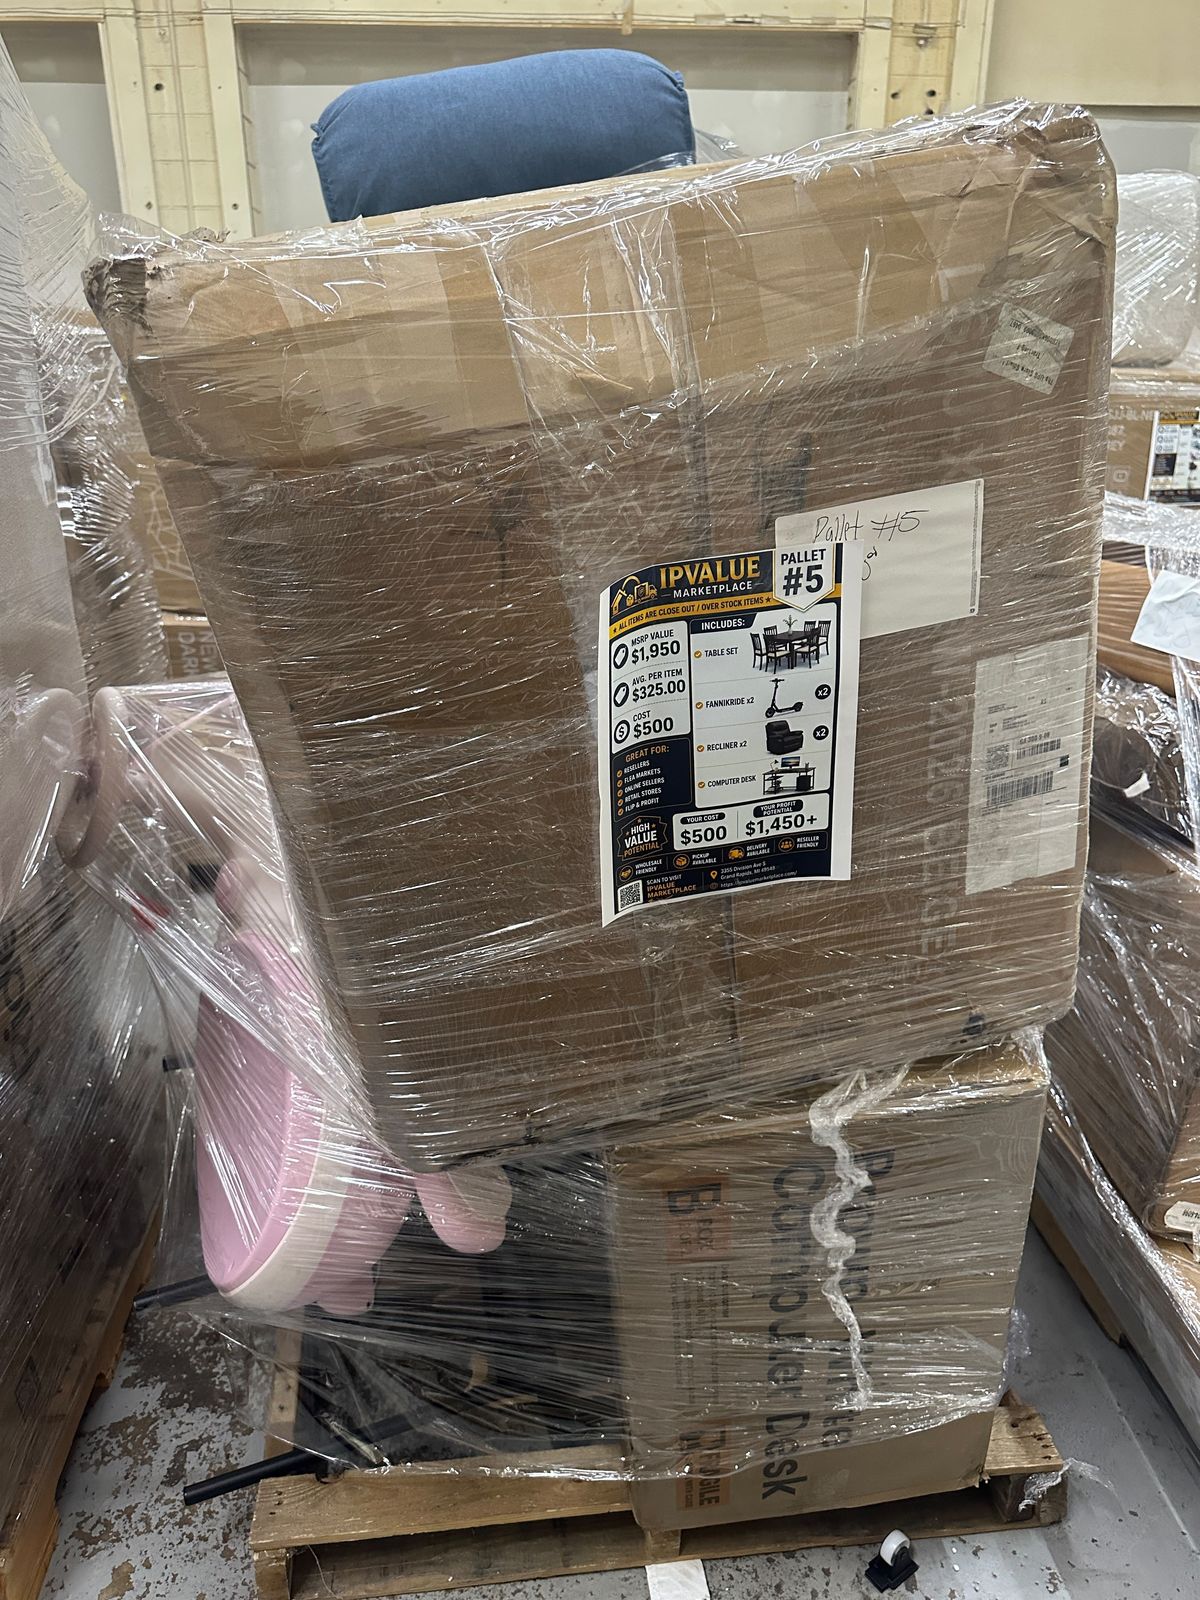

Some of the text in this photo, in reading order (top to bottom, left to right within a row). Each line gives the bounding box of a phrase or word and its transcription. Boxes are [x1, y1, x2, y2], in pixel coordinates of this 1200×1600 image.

[871, 510, 930, 542] #5
[781, 548, 827, 565] PALLET
[659, 555, 761, 589] IPVALUE
[782, 564, 824, 597] #5
[673, 581, 753, 599] MARKETPLACE
[628, 614, 644, 626] ITEMS
[645, 610, 657, 619] ARE
[659, 607, 680, 615] CLOSE
[682, 605, 696, 613] OUT
[721, 600, 742, 608] STOCK
[744, 597, 763, 606] ITEMS
[701, 618, 745, 630] INCLUDES:
[631, 629, 674, 647] MSRP VALUE
[631, 640, 680, 665] $1,950
[704, 648, 738, 658] TABLE SET
[632, 668, 682, 686] AVG. PER ITEM
[632, 679, 686, 703] $325.00
[817, 688, 829, 697] x2
[706, 698, 745, 708] FANNIKRIDE
[633, 710, 651, 722] COST
[633, 717, 674, 739] $500
[815, 729, 826, 737] x2
[707, 742, 738, 751] RECLINER
[625, 745, 670, 763] GREAT FOR:
[624, 760, 650, 774] RESELLERS
[624, 768, 661, 784] FLEA MARKETS
[707, 775, 756, 788] COMPUTER DESK
[624, 777, 665, 793] ONLINE SELLERS
[625, 788, 662, 802] RETAIL STORES
[625, 802, 635, 812] FLIP
[641, 798, 659, 807] PROFIT
[763, 807, 793, 816] POTENTIAL
[631, 822, 650, 834] HIGH
[745, 814, 817, 836] $1,450+
[624, 831, 657, 848] VALUE
[680, 826, 727, 845] $500
[624, 842, 660, 857] POTENTIAL
[747, 843, 767, 851] DELIVERY
[747, 848, 770, 856] AVAILABLE
[635, 859, 662, 869] WHOLESALE
[636, 867, 657, 875] FRIENDLY
[647, 877, 661, 885] SCAN
[647, 881, 675, 892] IPVALUE
[648, 885, 696, 898] MARKETPLACE
[752, 1162, 826, 1500] Computer Desk
